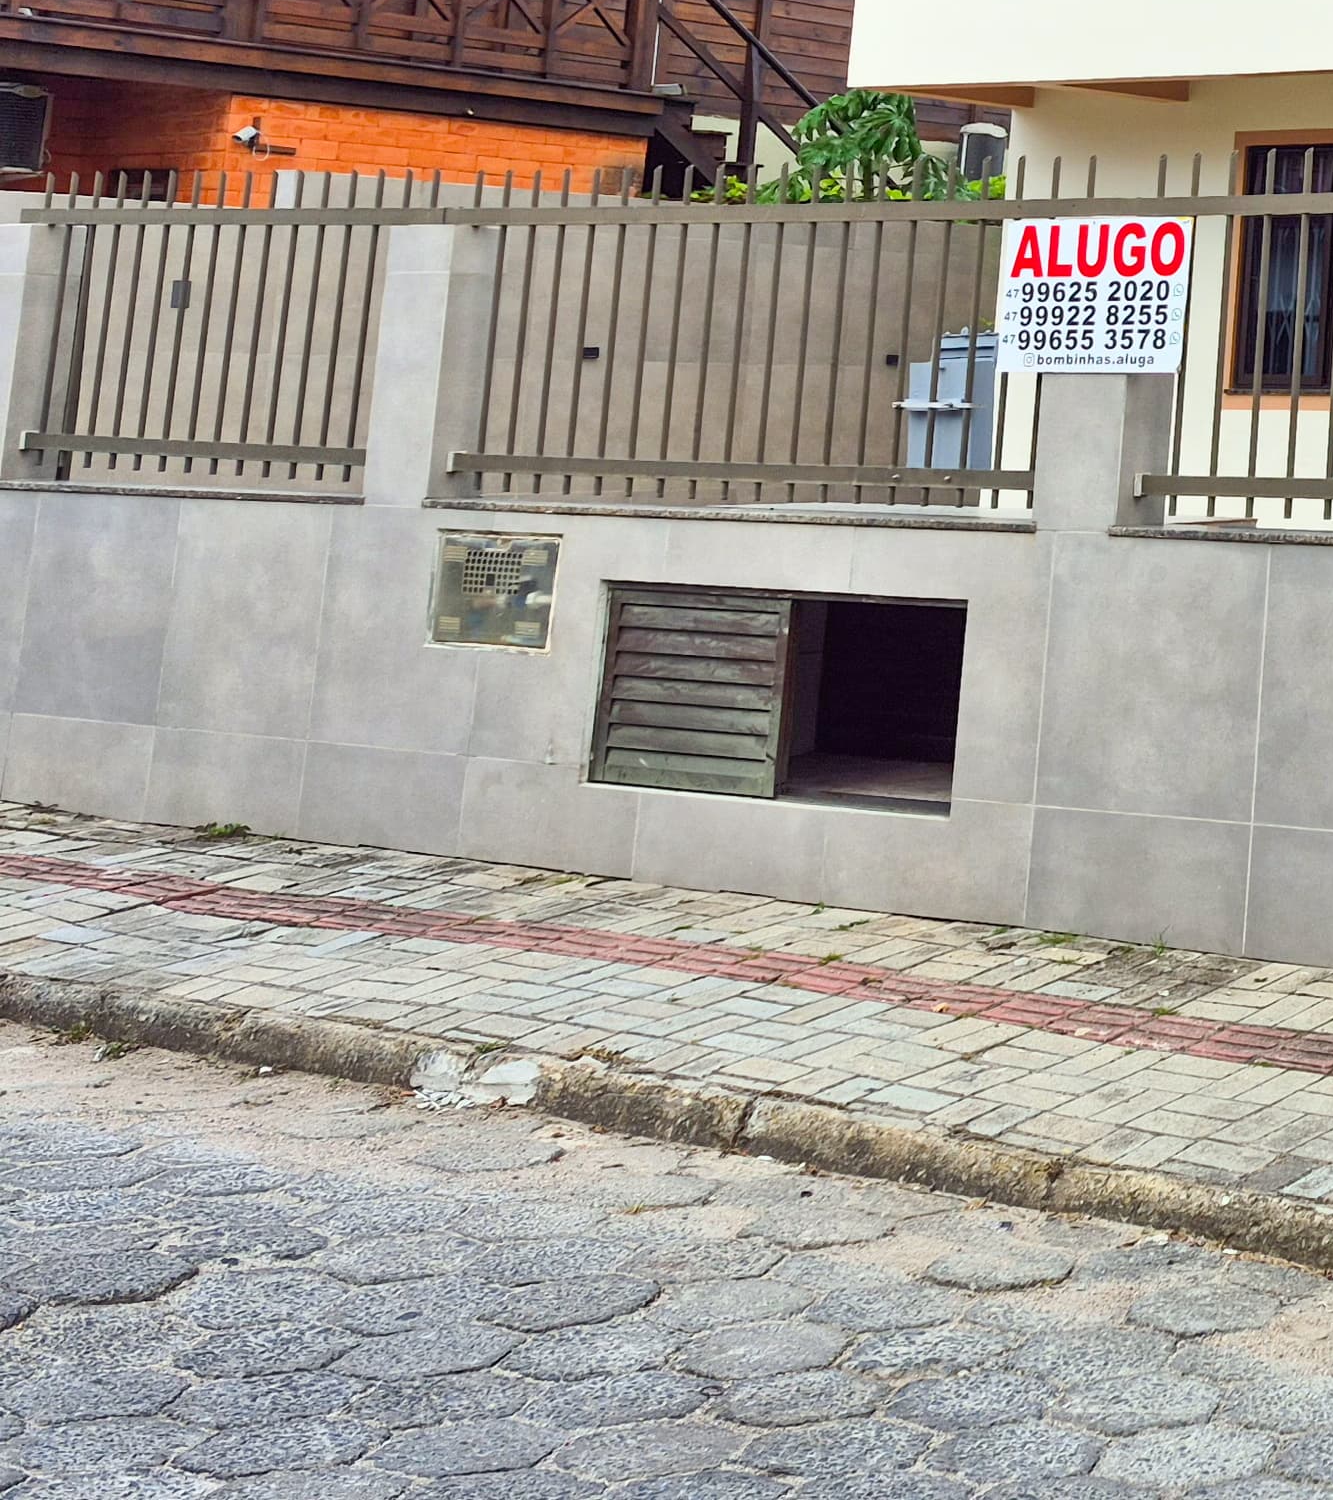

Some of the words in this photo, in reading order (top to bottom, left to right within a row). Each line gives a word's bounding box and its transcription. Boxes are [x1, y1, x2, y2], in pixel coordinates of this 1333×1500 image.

[1010, 221, 1185, 278] ALUGO
[1005, 288, 1020, 299] 47
[1021, 281, 1098, 303] 99625
[1107, 280, 1170, 302] 2020
[1004, 311, 1018, 322] 47
[1019, 305, 1096, 327] 99922
[1105, 304, 1169, 326] 8255
[1002, 334, 1016, 345] 47
[1018, 329, 1095, 351] 99655
[1104, 328, 1167, 350] 3578
[1037, 353, 1155, 368] bombinhas.aluga
